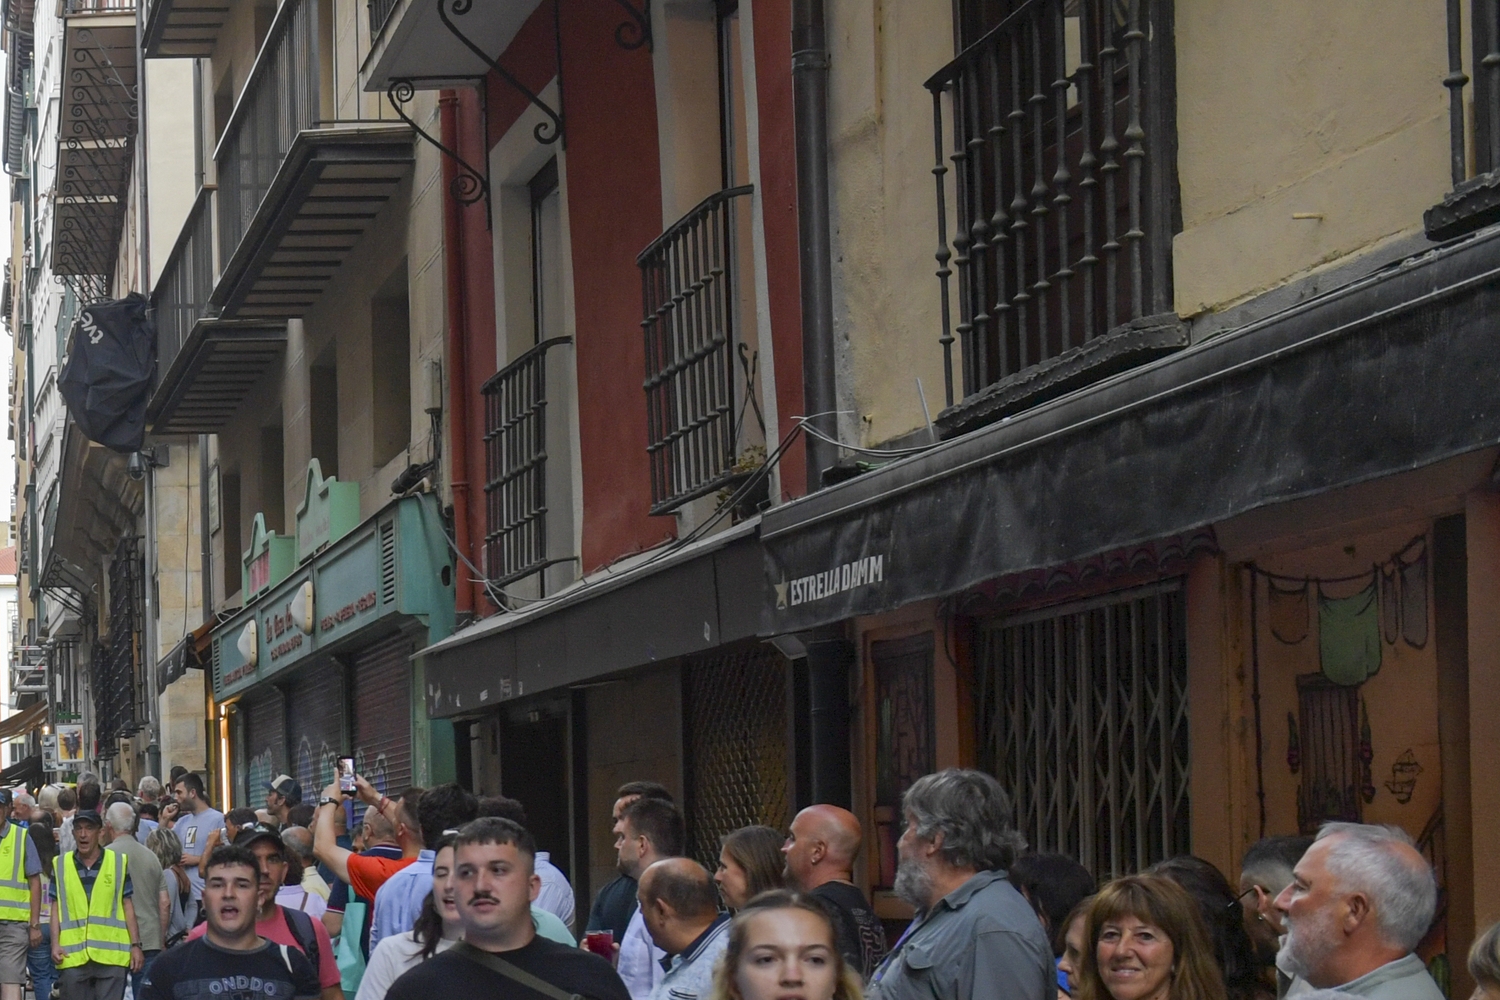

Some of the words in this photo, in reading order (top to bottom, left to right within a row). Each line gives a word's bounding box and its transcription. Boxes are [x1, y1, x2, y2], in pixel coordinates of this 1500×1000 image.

[790, 567, 840, 606] ESTRELLA
[841, 554, 883, 591] DAMM
[209, 975, 277, 996] ONDDO
